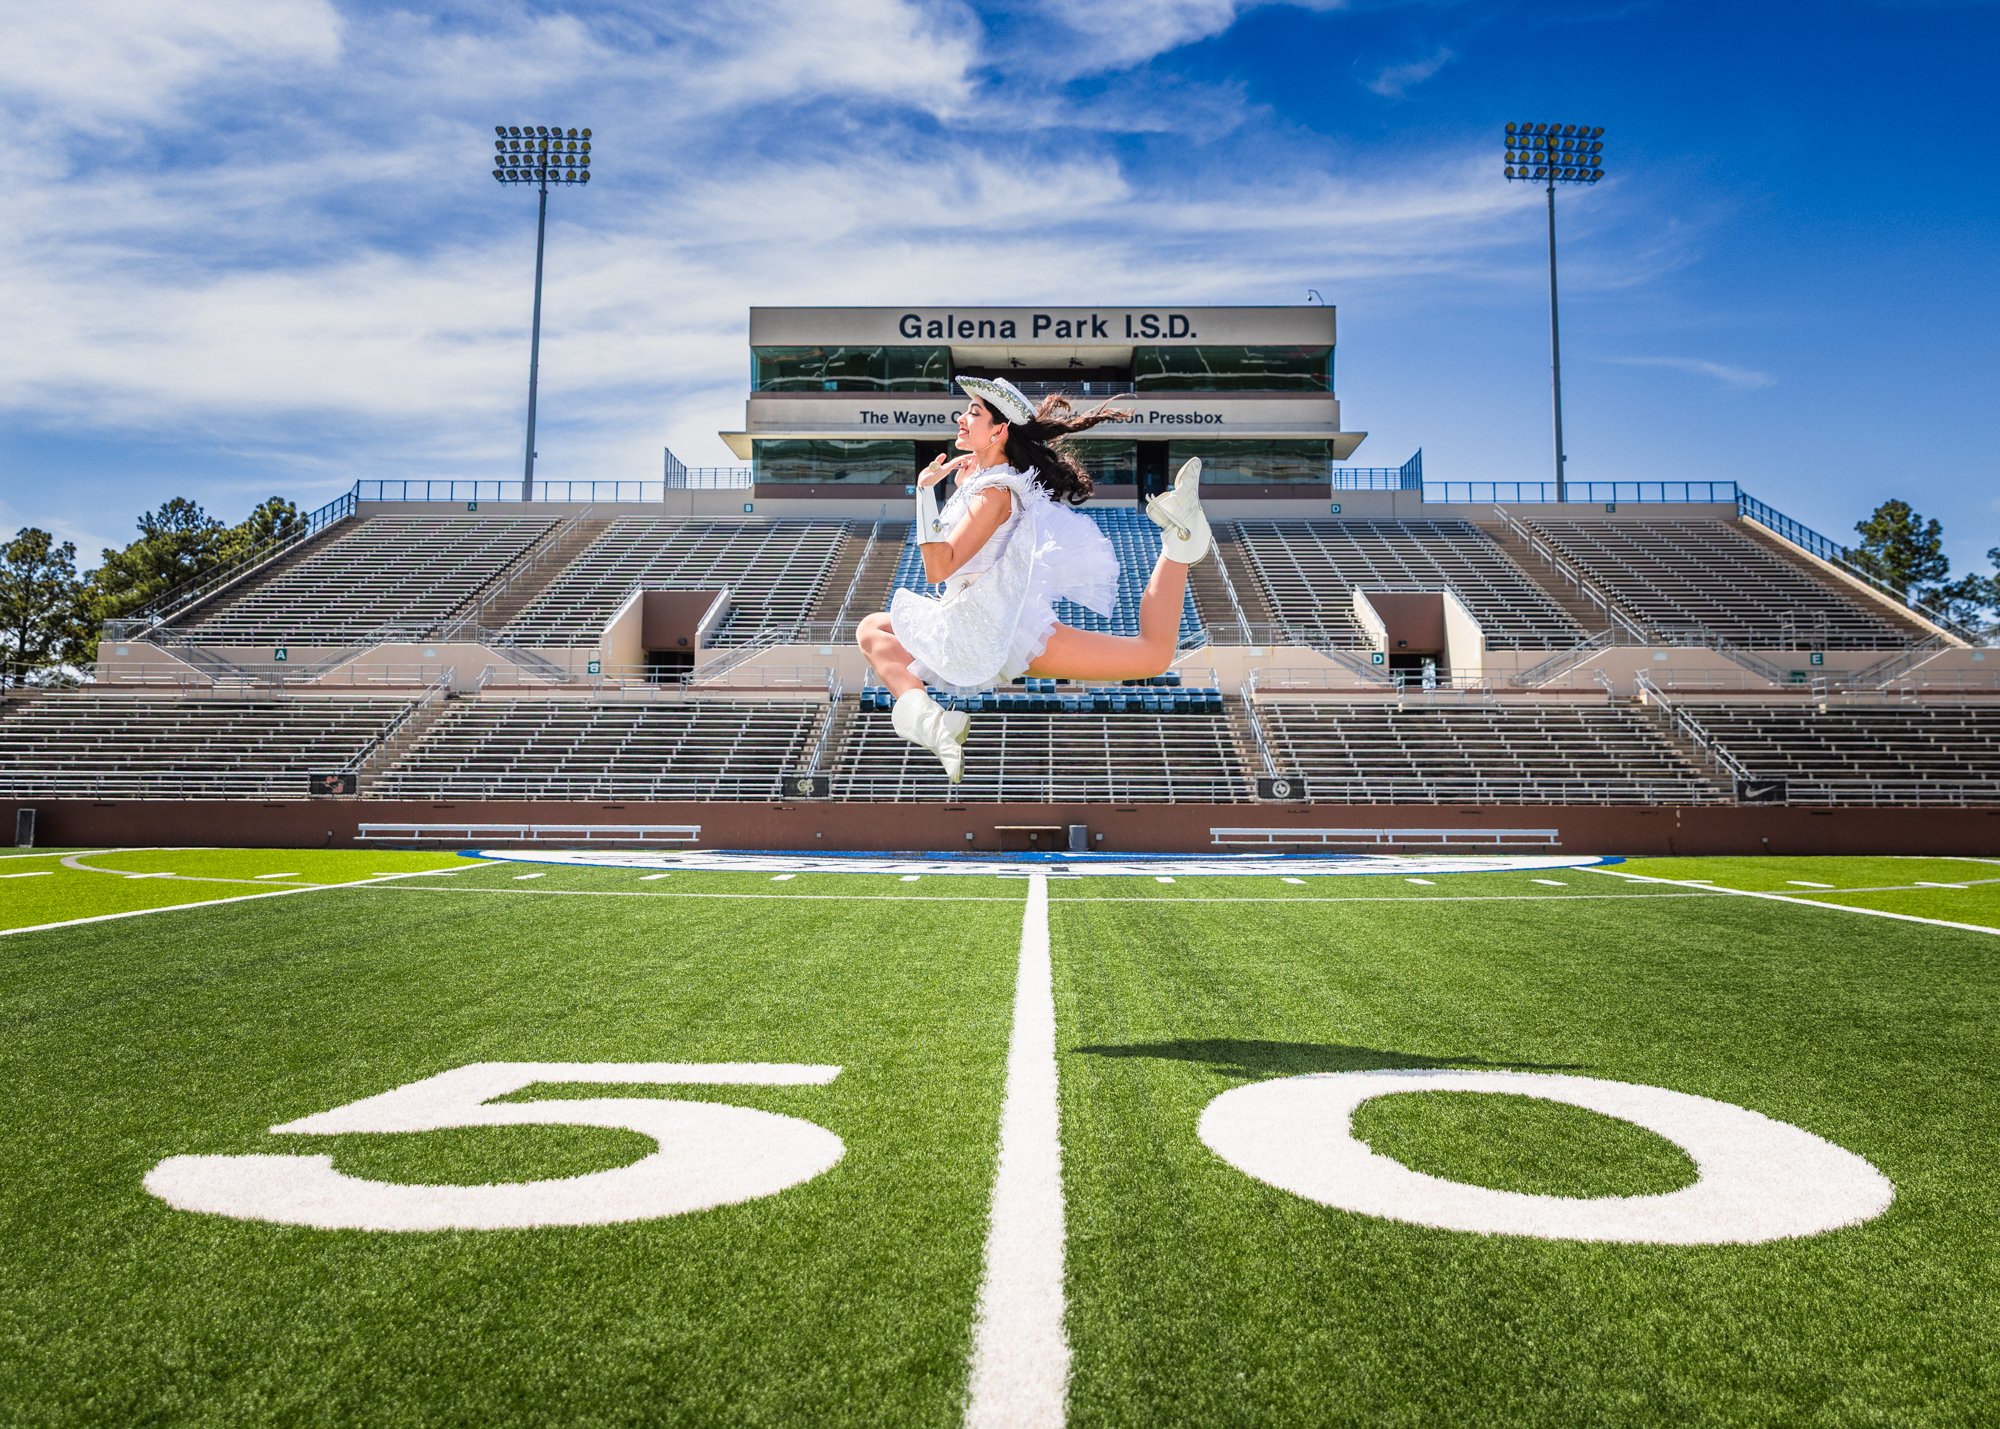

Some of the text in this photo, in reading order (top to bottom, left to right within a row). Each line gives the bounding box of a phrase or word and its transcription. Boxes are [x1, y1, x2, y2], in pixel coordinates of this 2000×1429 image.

[899, 313, 1197, 339] Galena Park I.S.D.
[860, 410, 889, 424] The
[893, 410, 946, 427] Wayne
[1149, 410, 1223, 424] Pressbox
[1332, 505, 1340, 513] D
[275, 649, 286, 660] A
[1372, 654, 1383, 664] D
[1812, 654, 1822, 664] E
